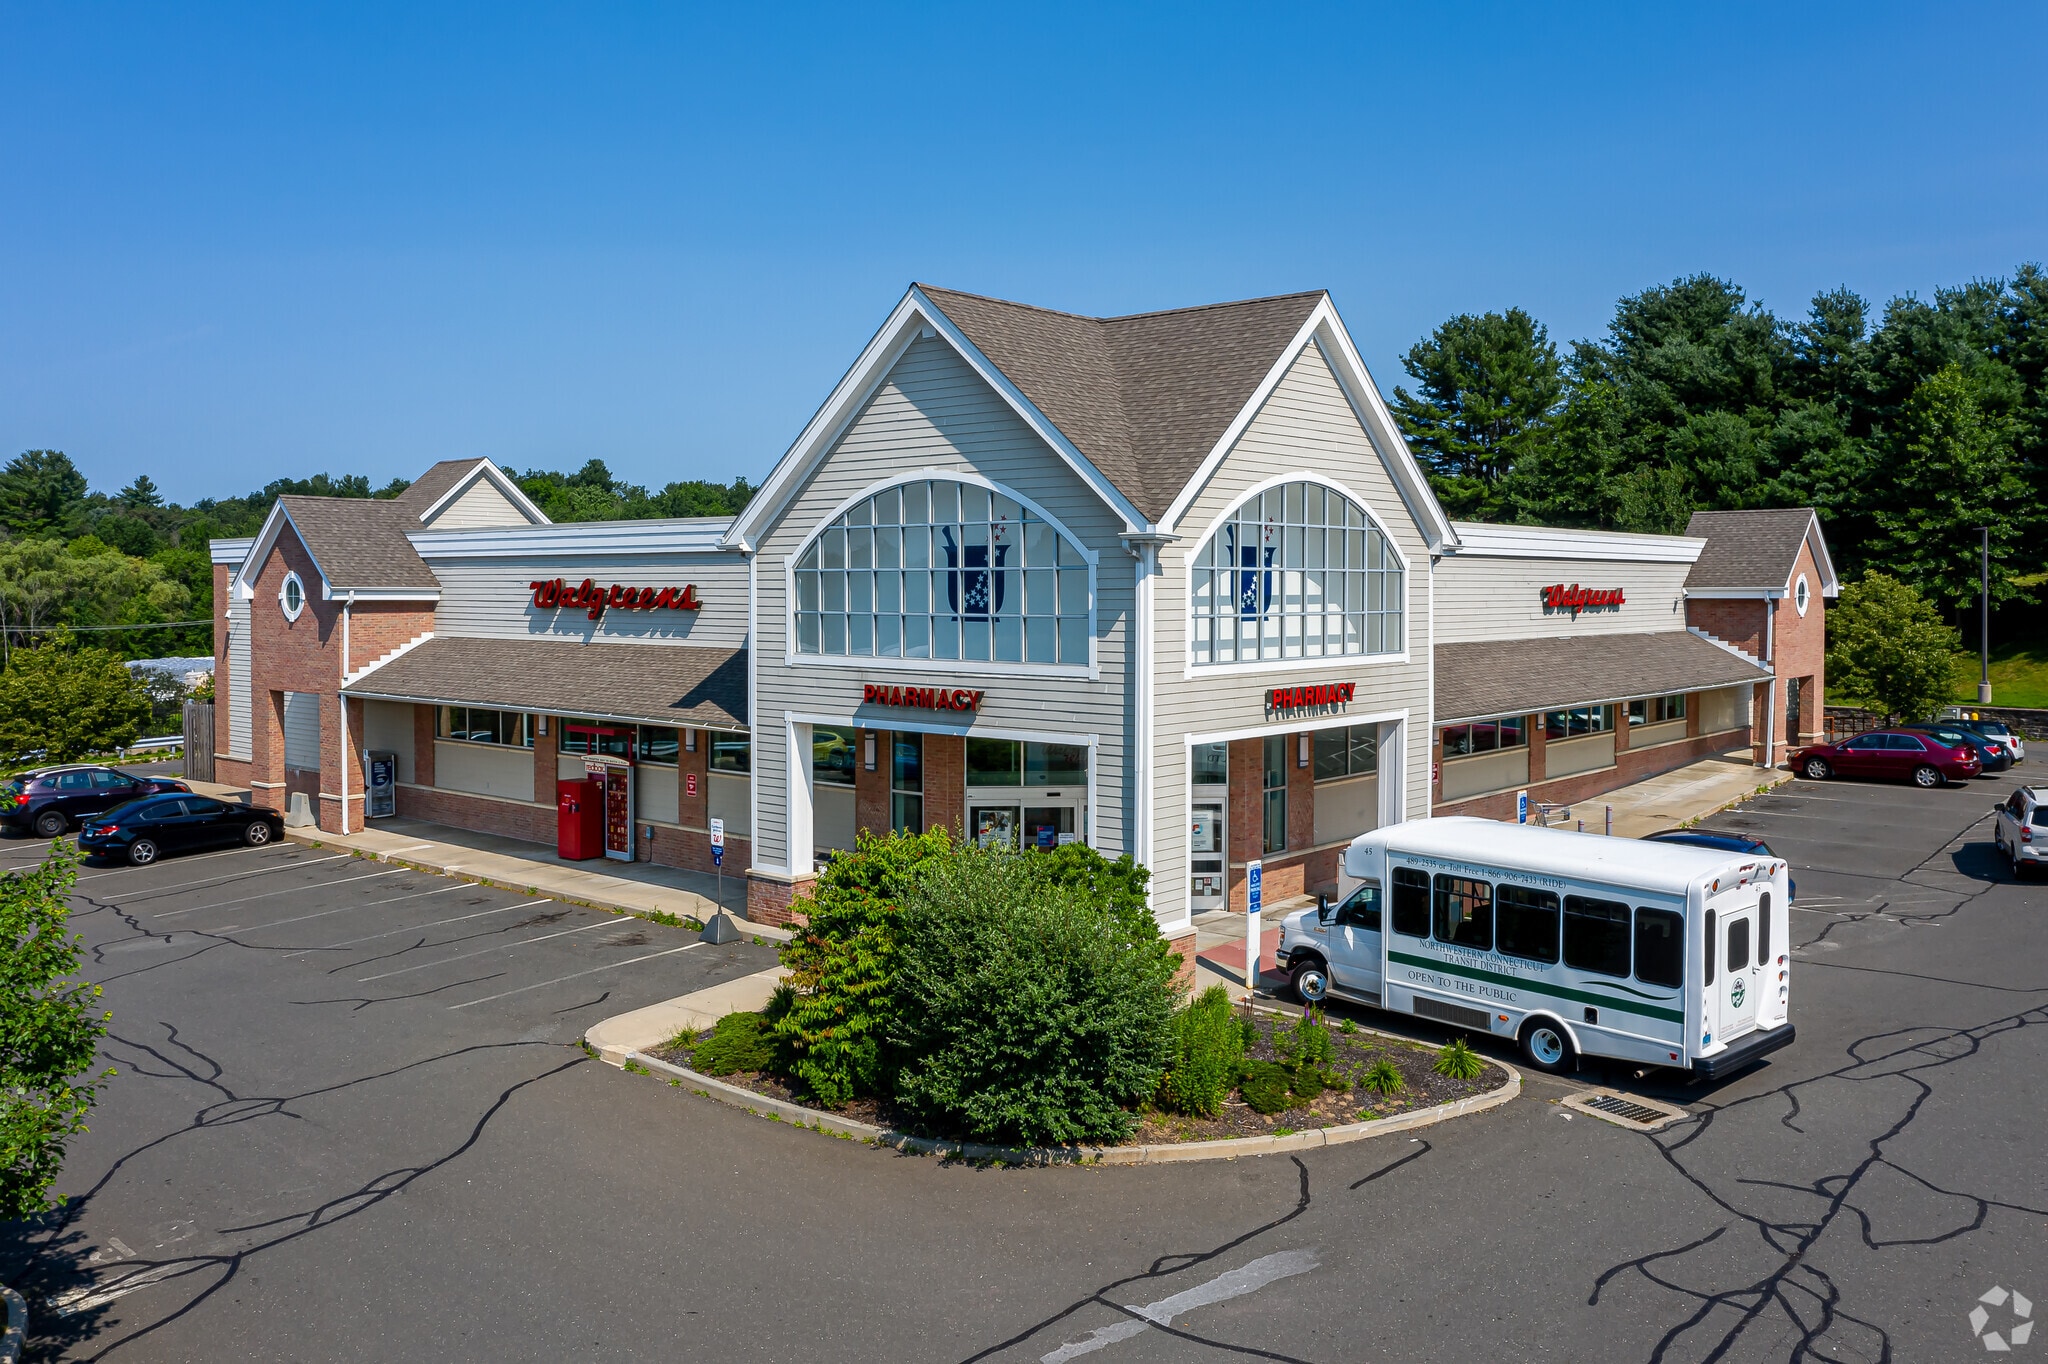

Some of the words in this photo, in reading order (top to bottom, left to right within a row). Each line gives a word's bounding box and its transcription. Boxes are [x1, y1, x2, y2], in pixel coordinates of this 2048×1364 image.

[529, 577, 700, 620] Walgreens
[1545, 583, 1626, 613] Walgreens
[864, 684, 980, 711] PHARMACY
[1273, 682, 1356, 710] PHARMACY
[1364, 847, 1373, 856] 45
[1406, 856, 1437, 868] 489-2535
[1438, 862, 1446, 870] or
[1449, 862, 1462, 873] Toll
[1464, 865, 1479, 876] Free
[1481, 868, 1537, 884] 1-866-906-7433
[1539, 877, 1567, 889] (RIDE)
[1420, 939, 1483, 960] NORTHWESTERN
[1485, 952, 1545, 973] CONNECTICUT
[1444, 953, 1479, 968] TRANSIT
[1480, 961, 1518, 976] DISTRICT
[1408, 970, 1435, 983] OPEN
[1438, 976, 1452, 988] TO
[1454, 980, 1476, 993] THE
[1479, 985, 1517, 1002] PUBLIC
